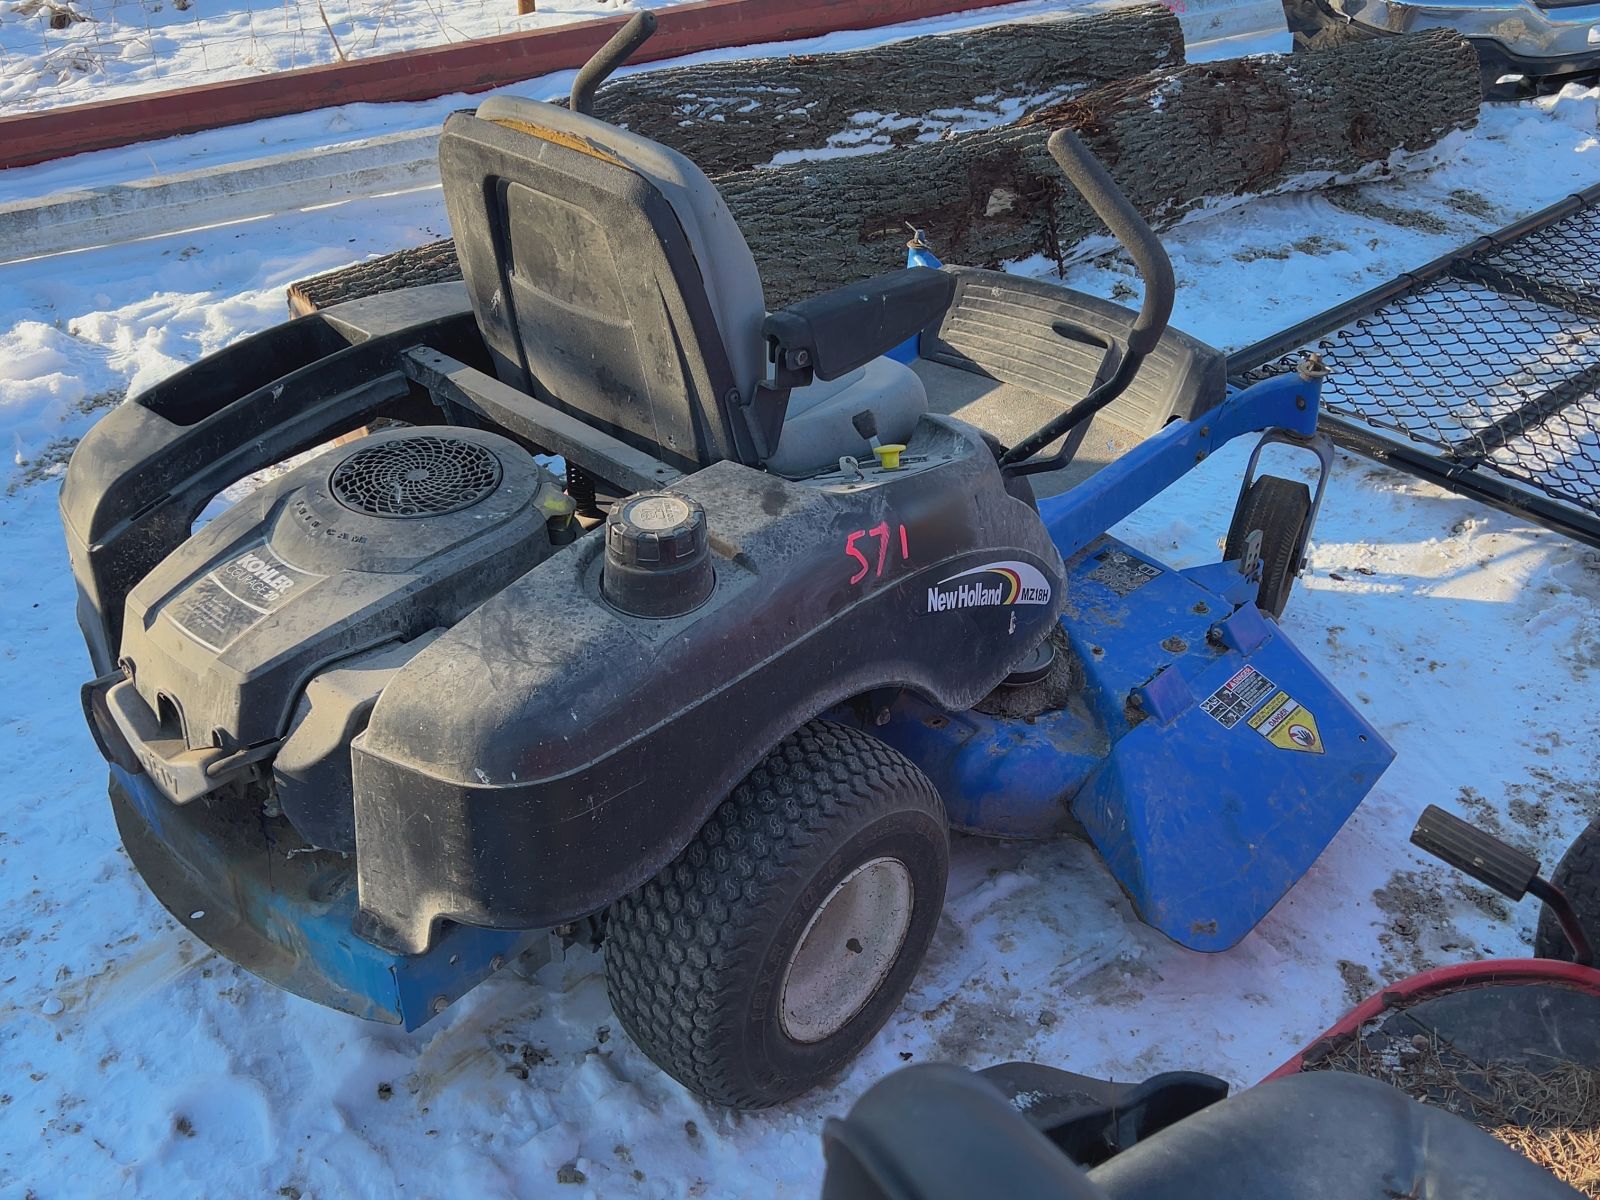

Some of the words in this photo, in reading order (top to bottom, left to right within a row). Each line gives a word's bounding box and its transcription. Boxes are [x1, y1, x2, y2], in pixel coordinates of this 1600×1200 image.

[845, 520, 909, 585] 571
[225, 565, 269, 597] COURAGE
[263, 590, 280, 602] 20
[237, 553, 294, 593] KOHLER
[927, 587, 957, 613] New
[957, 582, 1003, 609] Holland
[1021, 587, 1048, 601] MZ18H
[1268, 708, 1290, 727] DANGER
